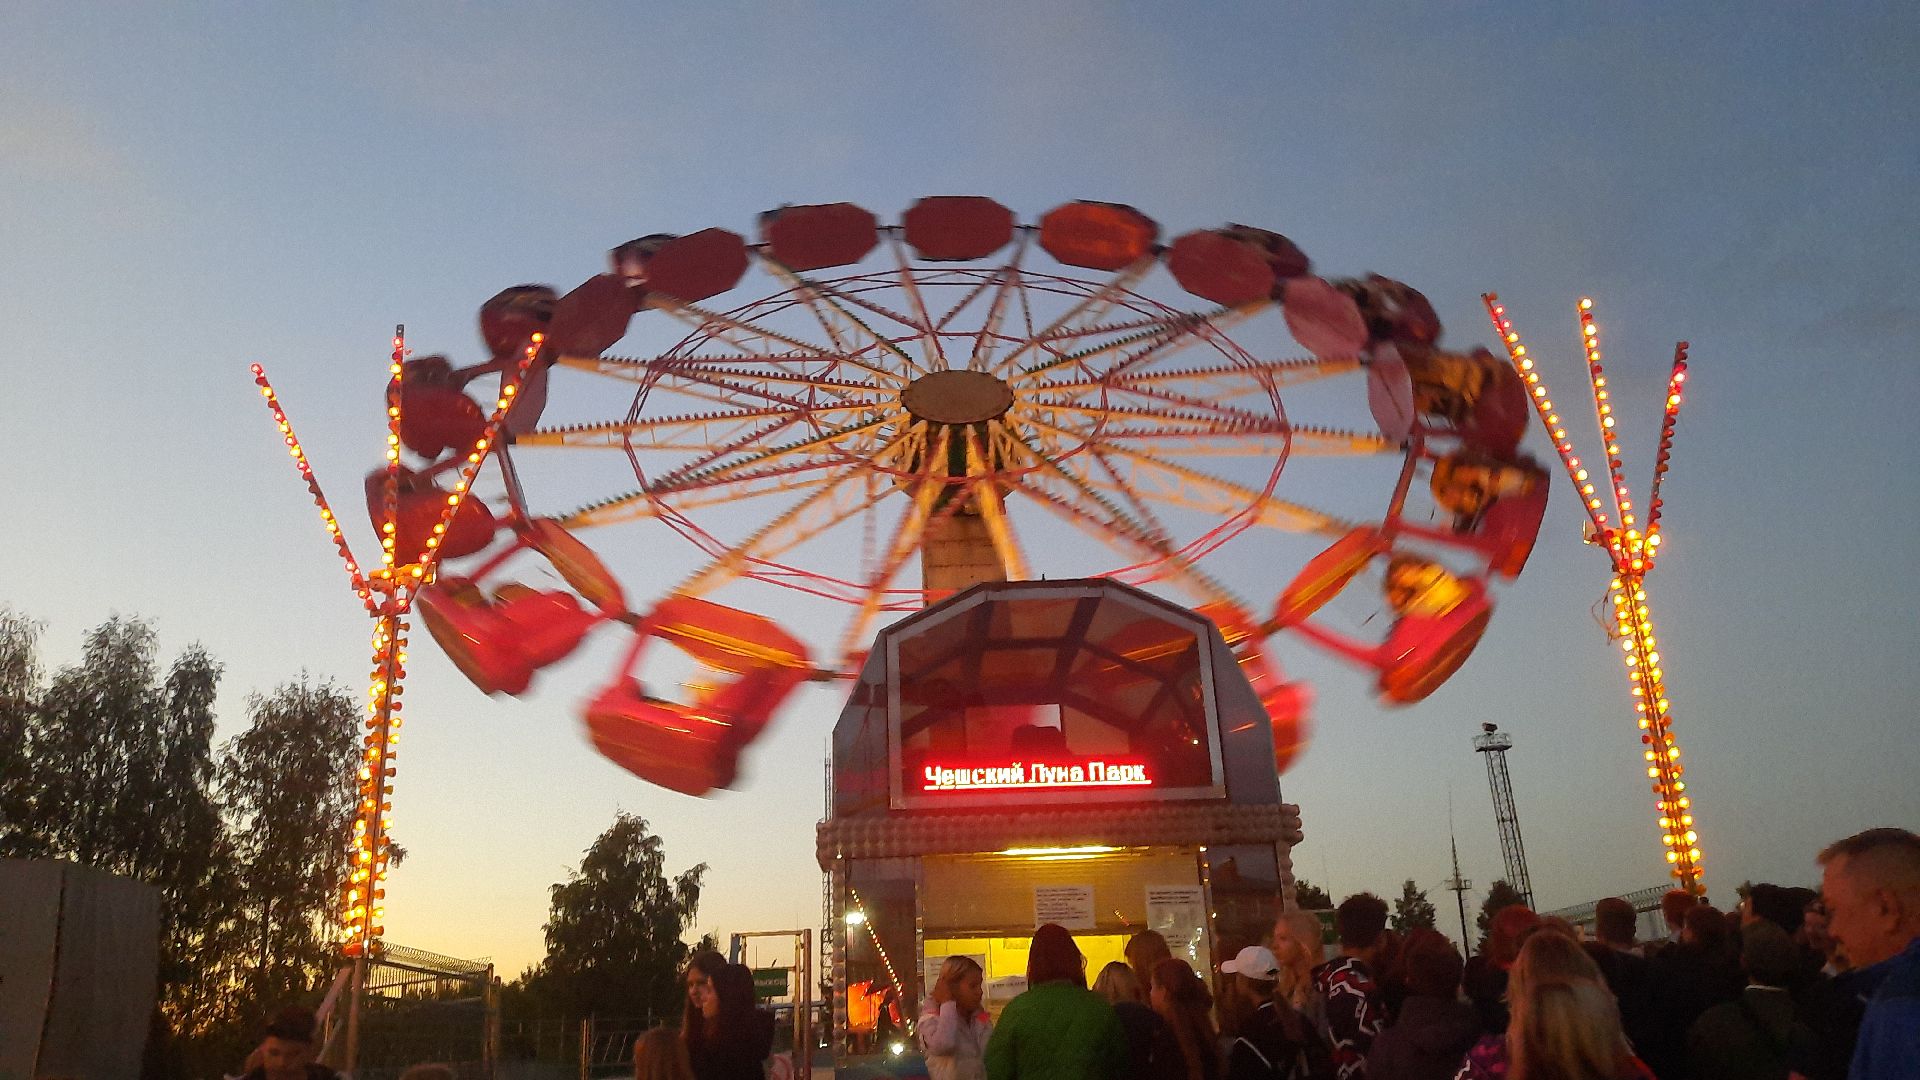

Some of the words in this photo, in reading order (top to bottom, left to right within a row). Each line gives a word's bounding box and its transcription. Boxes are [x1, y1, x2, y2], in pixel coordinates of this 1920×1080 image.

[925, 762, 1024, 786] Чешский
[1029, 763, 1084, 783] Луна
[1088, 761, 1145, 783] Парк
